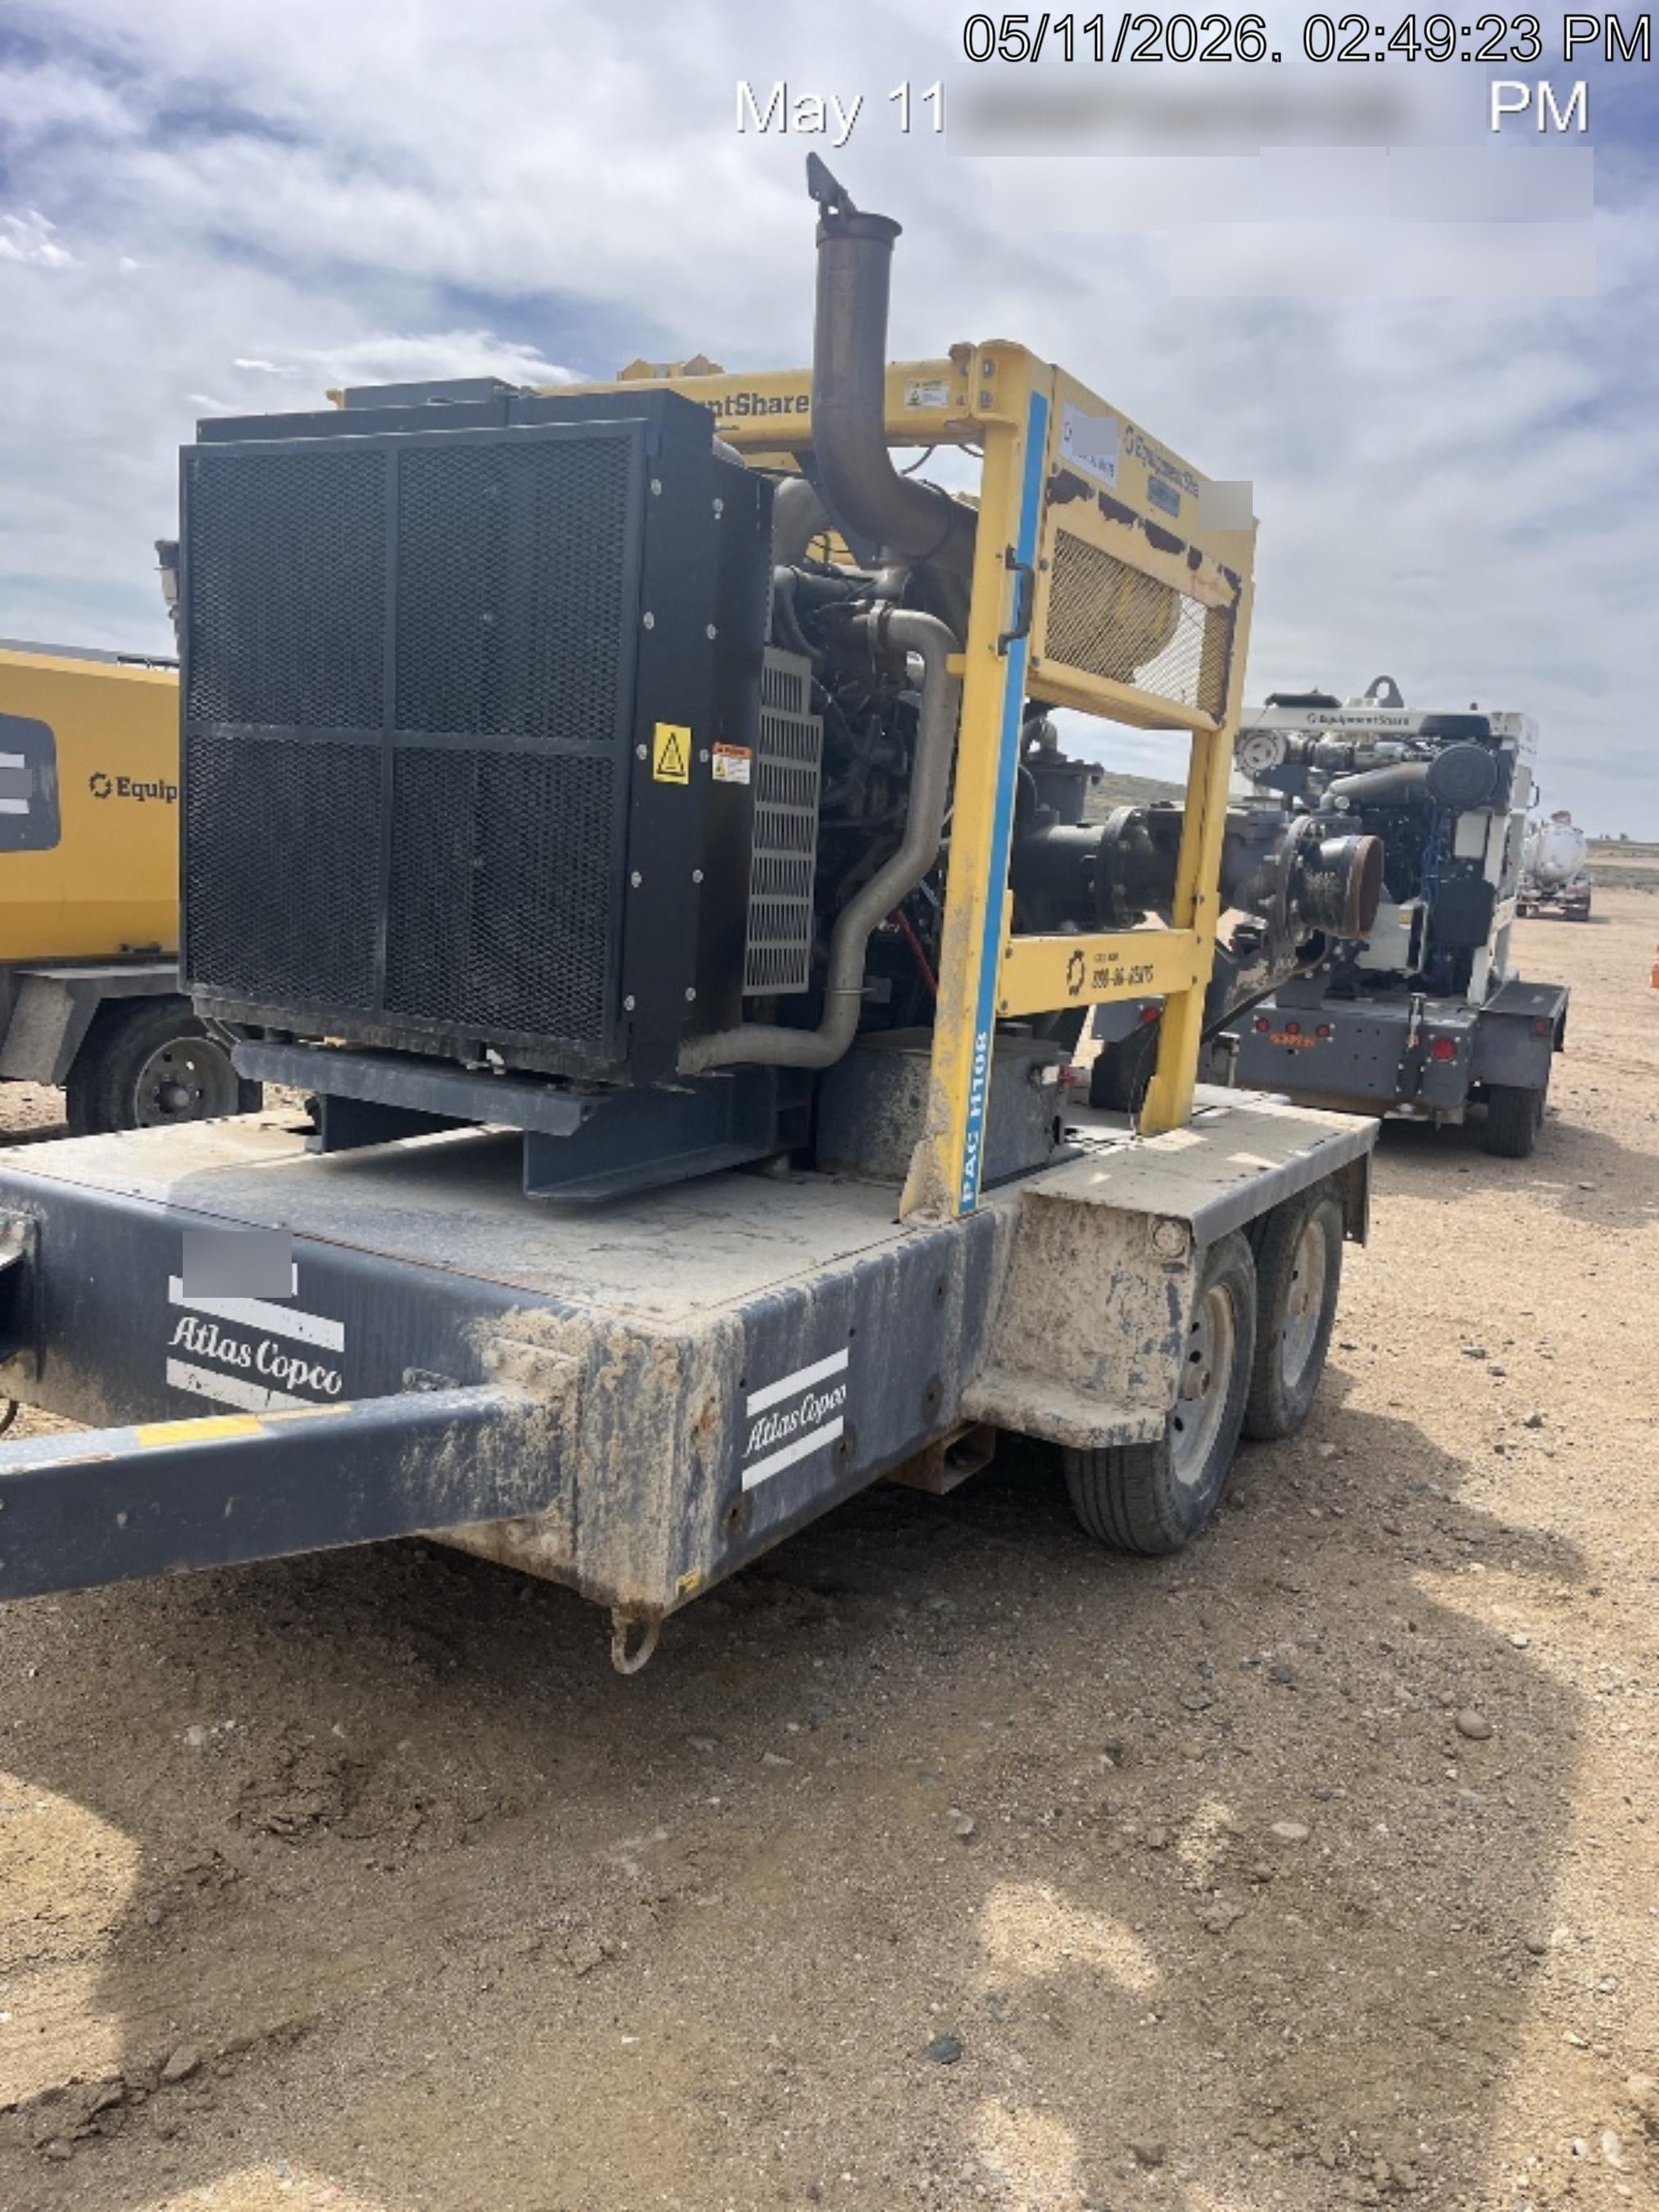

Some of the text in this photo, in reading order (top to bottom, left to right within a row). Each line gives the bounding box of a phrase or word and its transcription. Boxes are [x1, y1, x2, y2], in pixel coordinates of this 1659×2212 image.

[168, 1316, 342, 1394] Atlas Copco
[741, 1383, 846, 1457] Atlas Copco
